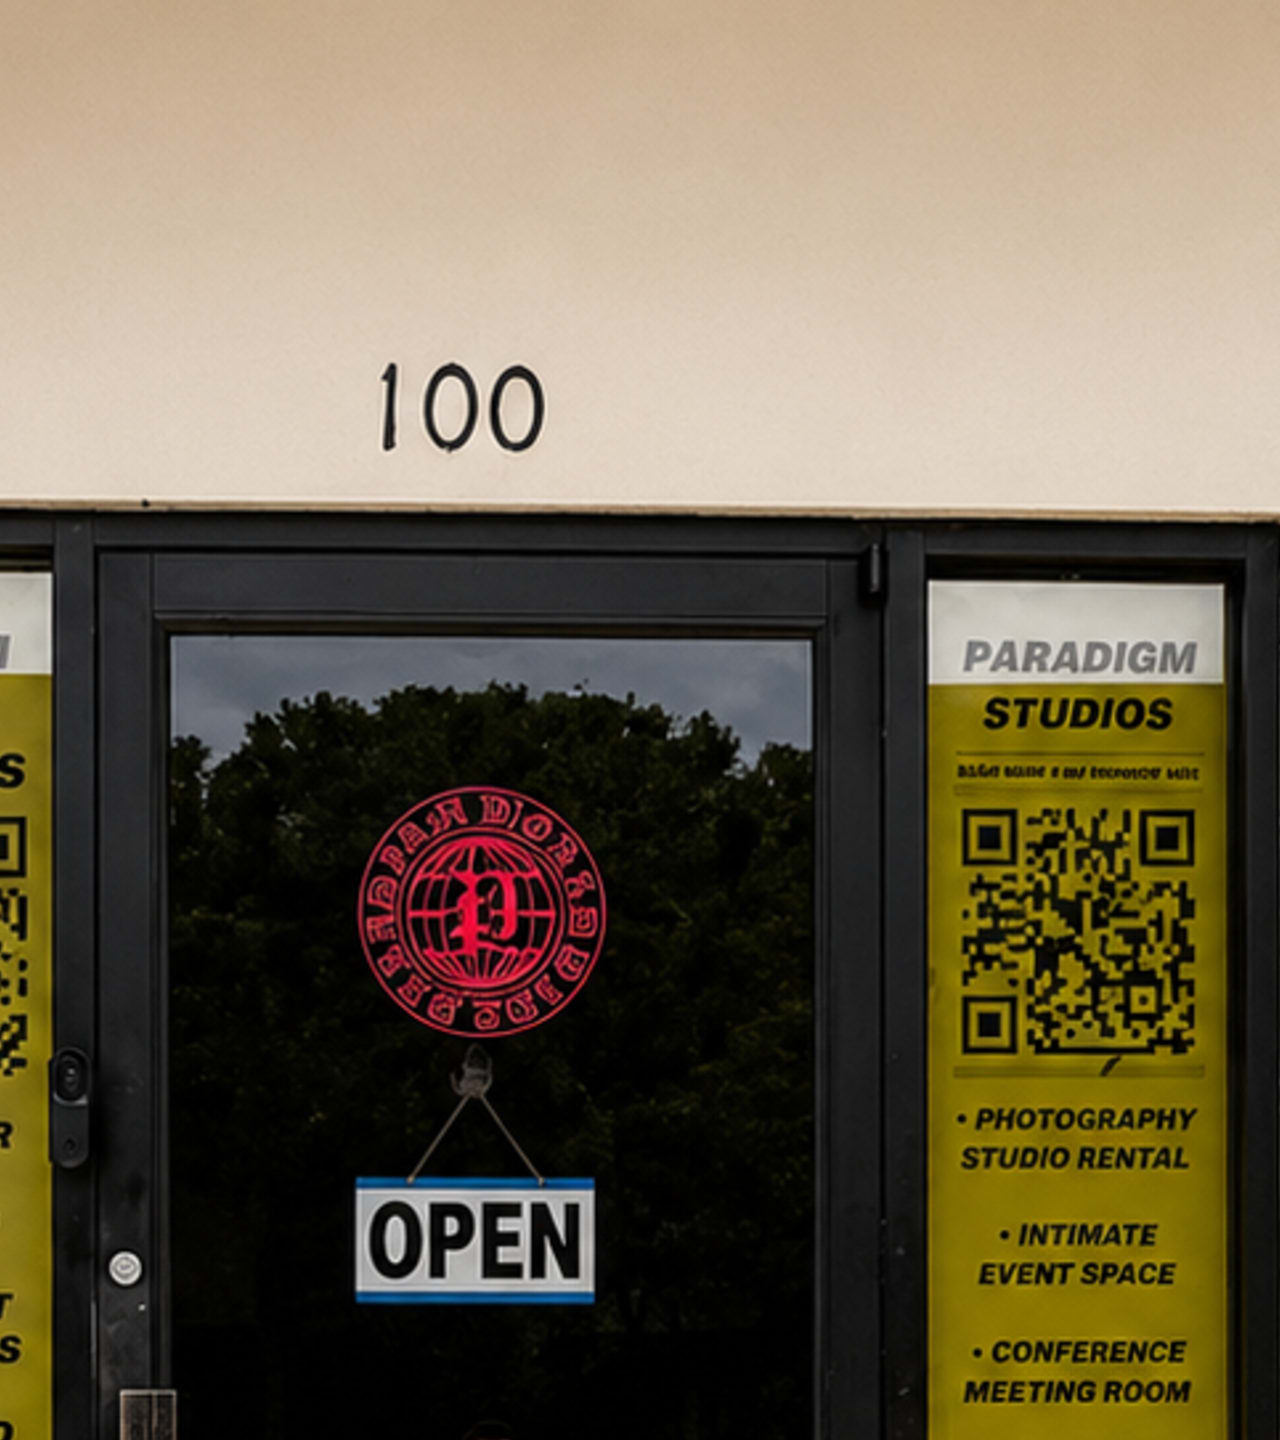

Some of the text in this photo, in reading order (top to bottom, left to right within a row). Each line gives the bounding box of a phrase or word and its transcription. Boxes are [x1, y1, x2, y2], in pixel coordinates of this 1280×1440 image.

[381, 362, 545, 453] 100
[963, 640, 1198, 675] PARADIGM
[983, 697, 1173, 731] STUDIOS
[975, 1107, 1198, 1131] PHOTOGRAPHY
[960, 1146, 1190, 1170] STUDIO RENTAL
[369, 1200, 580, 1280] OPEN
[1018, 1223, 1159, 1247] INTIMATE
[978, 1261, 1177, 1286] EVENT SPACE
[991, 1340, 1188, 1364] CONFERENCE
[963, 1380, 1192, 1404] MEETING ROOM
